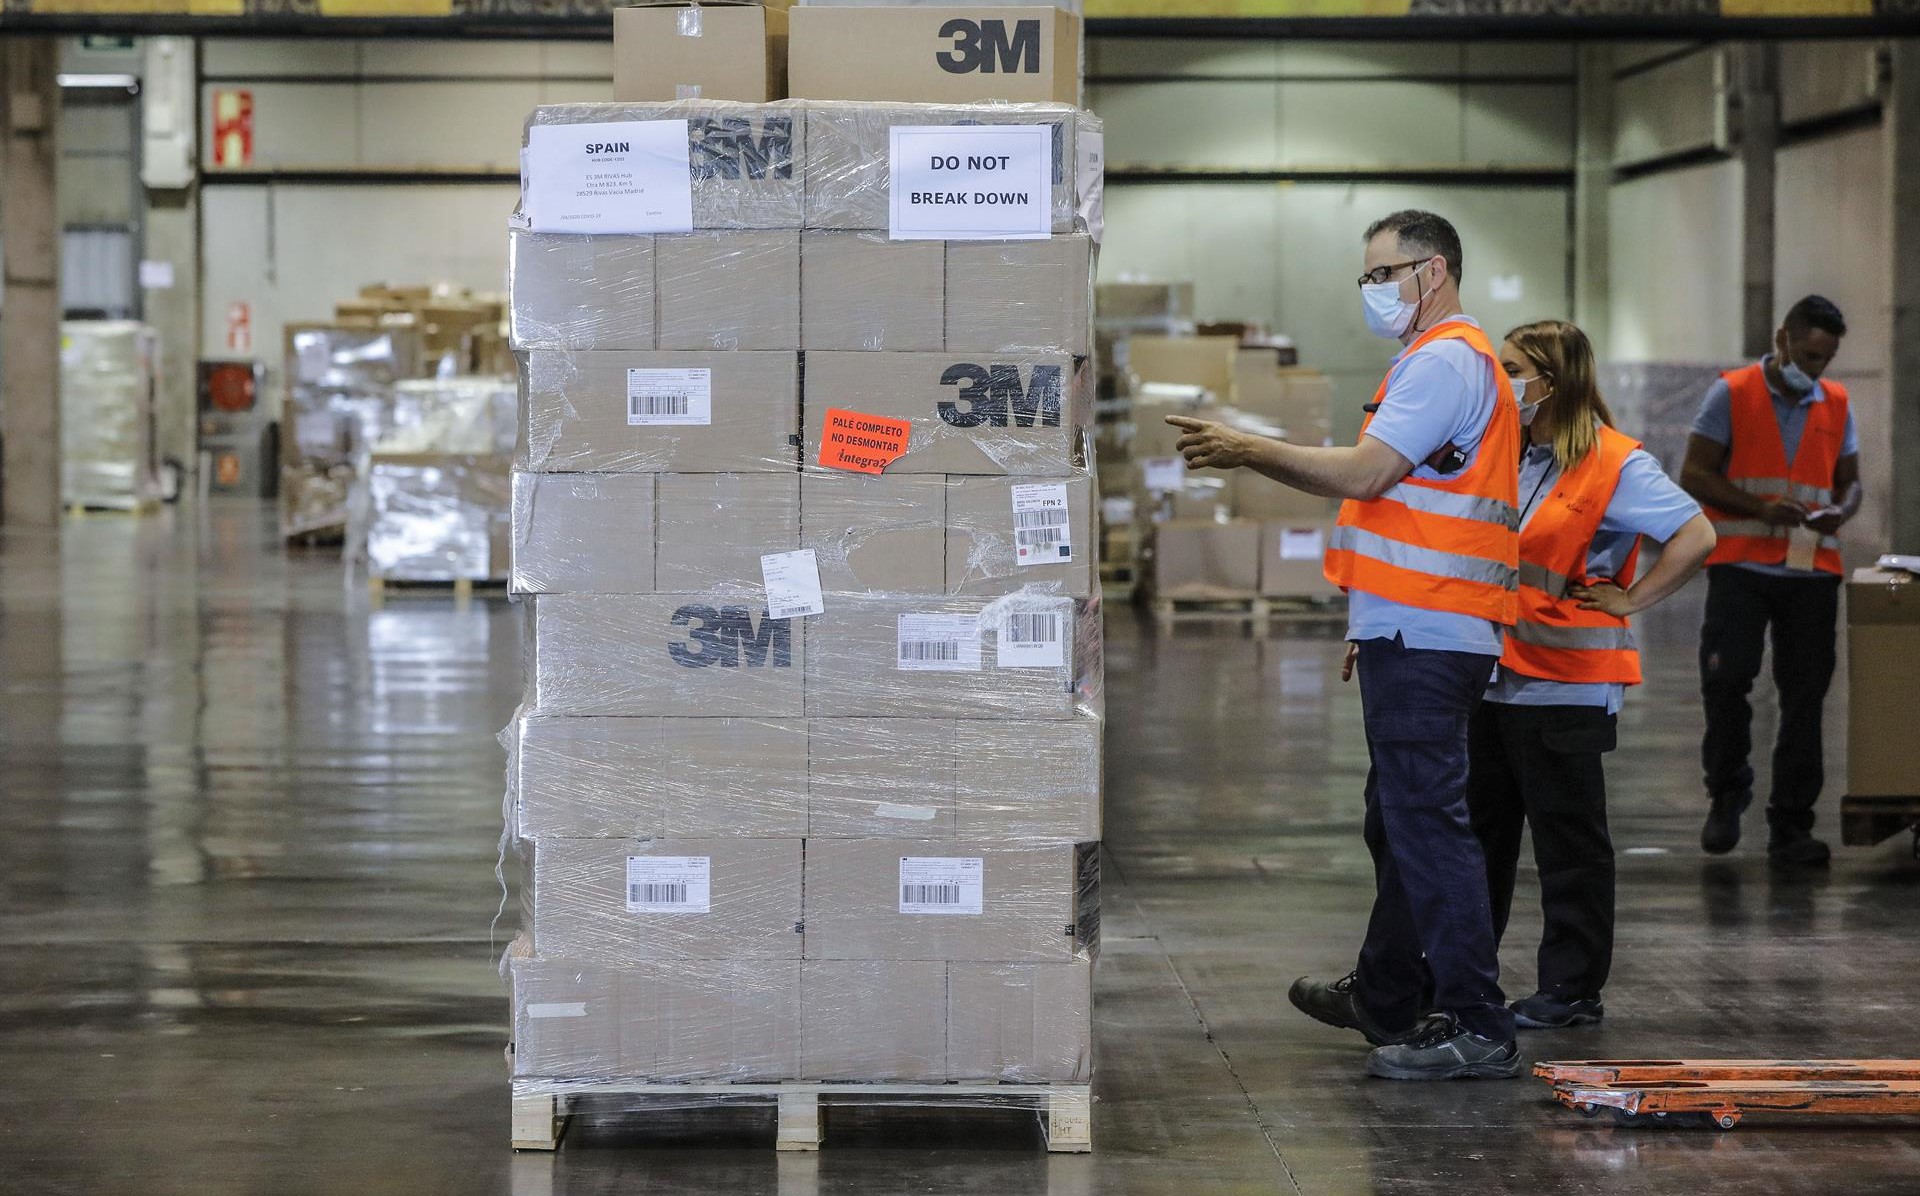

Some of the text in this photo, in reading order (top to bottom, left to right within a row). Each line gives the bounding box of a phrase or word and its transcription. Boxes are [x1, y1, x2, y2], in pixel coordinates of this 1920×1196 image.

[936, 18, 1040, 74] 3M
[585, 142, 630, 154] SPAIN
[930, 156, 1010, 170] DO NOT
[911, 192, 1029, 205] BREAK DOWN
[937, 363, 1061, 428] 3M
[832, 417, 903, 437] PALÉ COMPLETO
[831, 433, 899, 452] NO DESMONTAR
[838, 448, 887, 469] integra2
[667, 603, 792, 668] 3M
